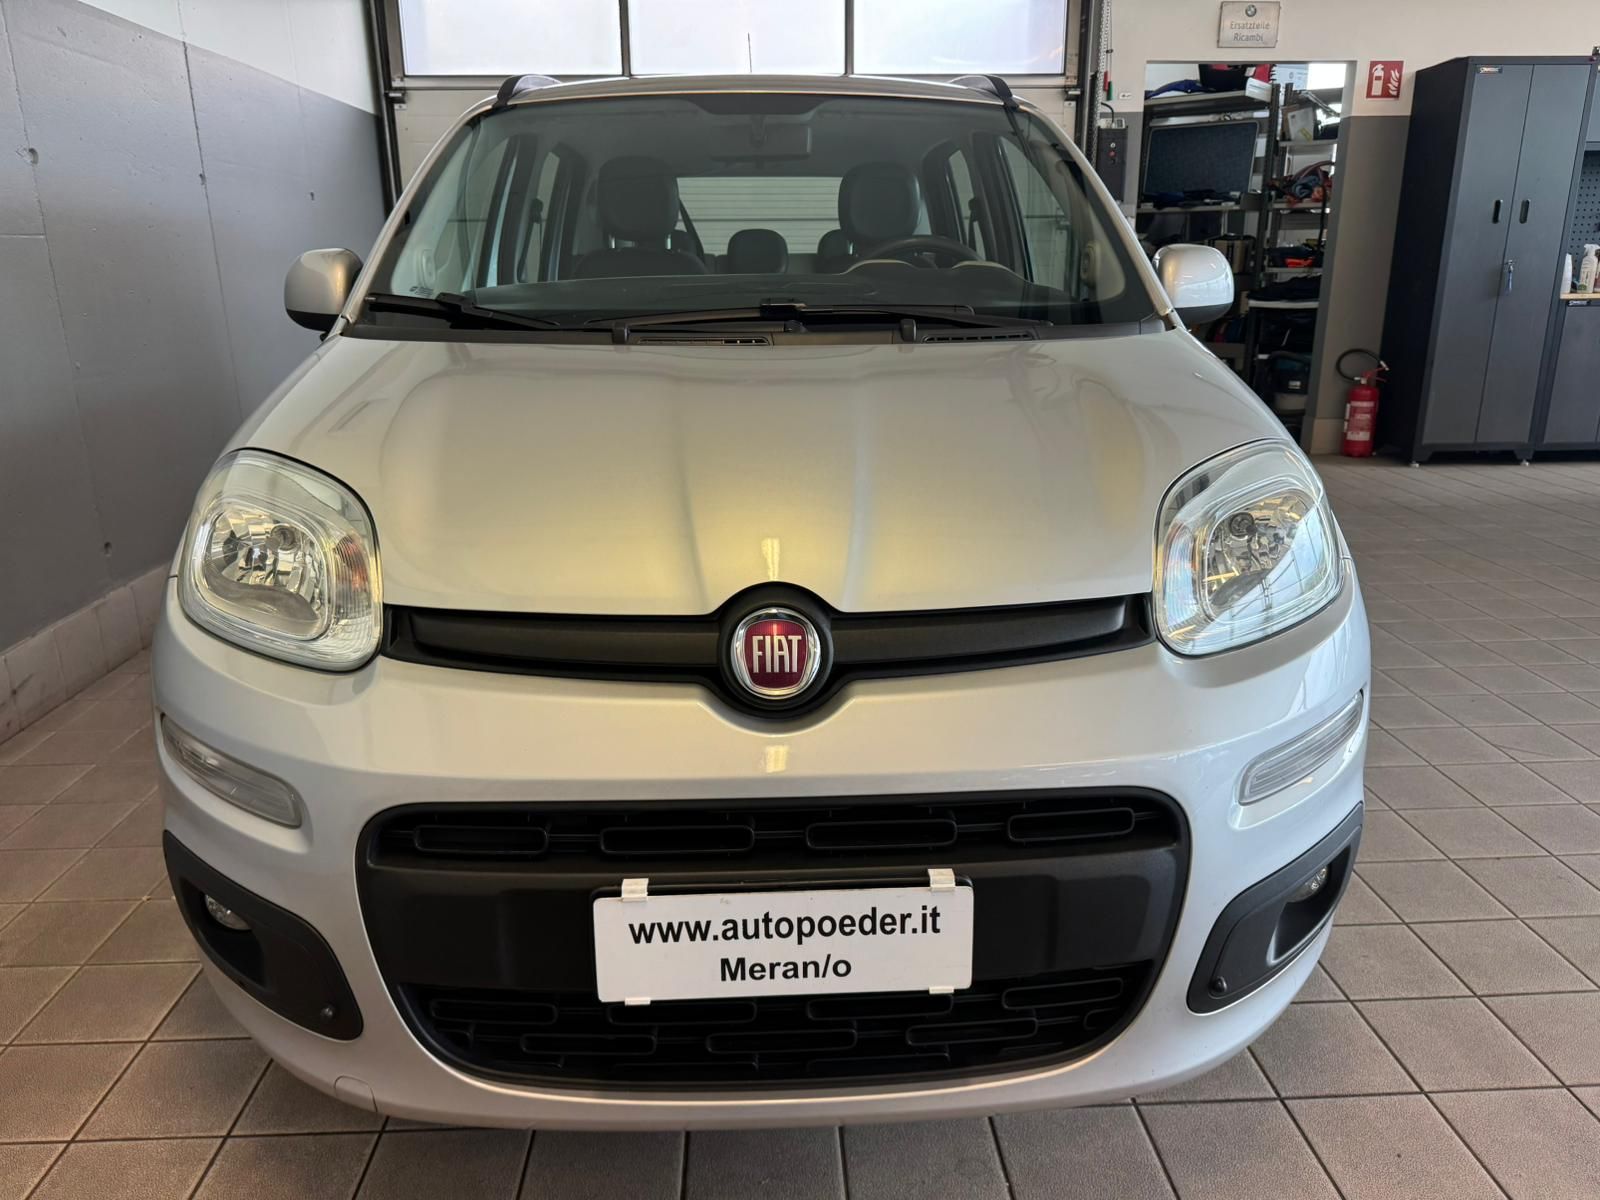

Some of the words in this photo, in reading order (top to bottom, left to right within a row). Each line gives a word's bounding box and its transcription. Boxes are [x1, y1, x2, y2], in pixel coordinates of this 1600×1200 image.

[1233, 32, 1264, 41] Ricambi
[752, 635, 802, 673] FIAT
[628, 905, 941, 945] www.autopoeder.it
[719, 954, 852, 982] Meran/o
